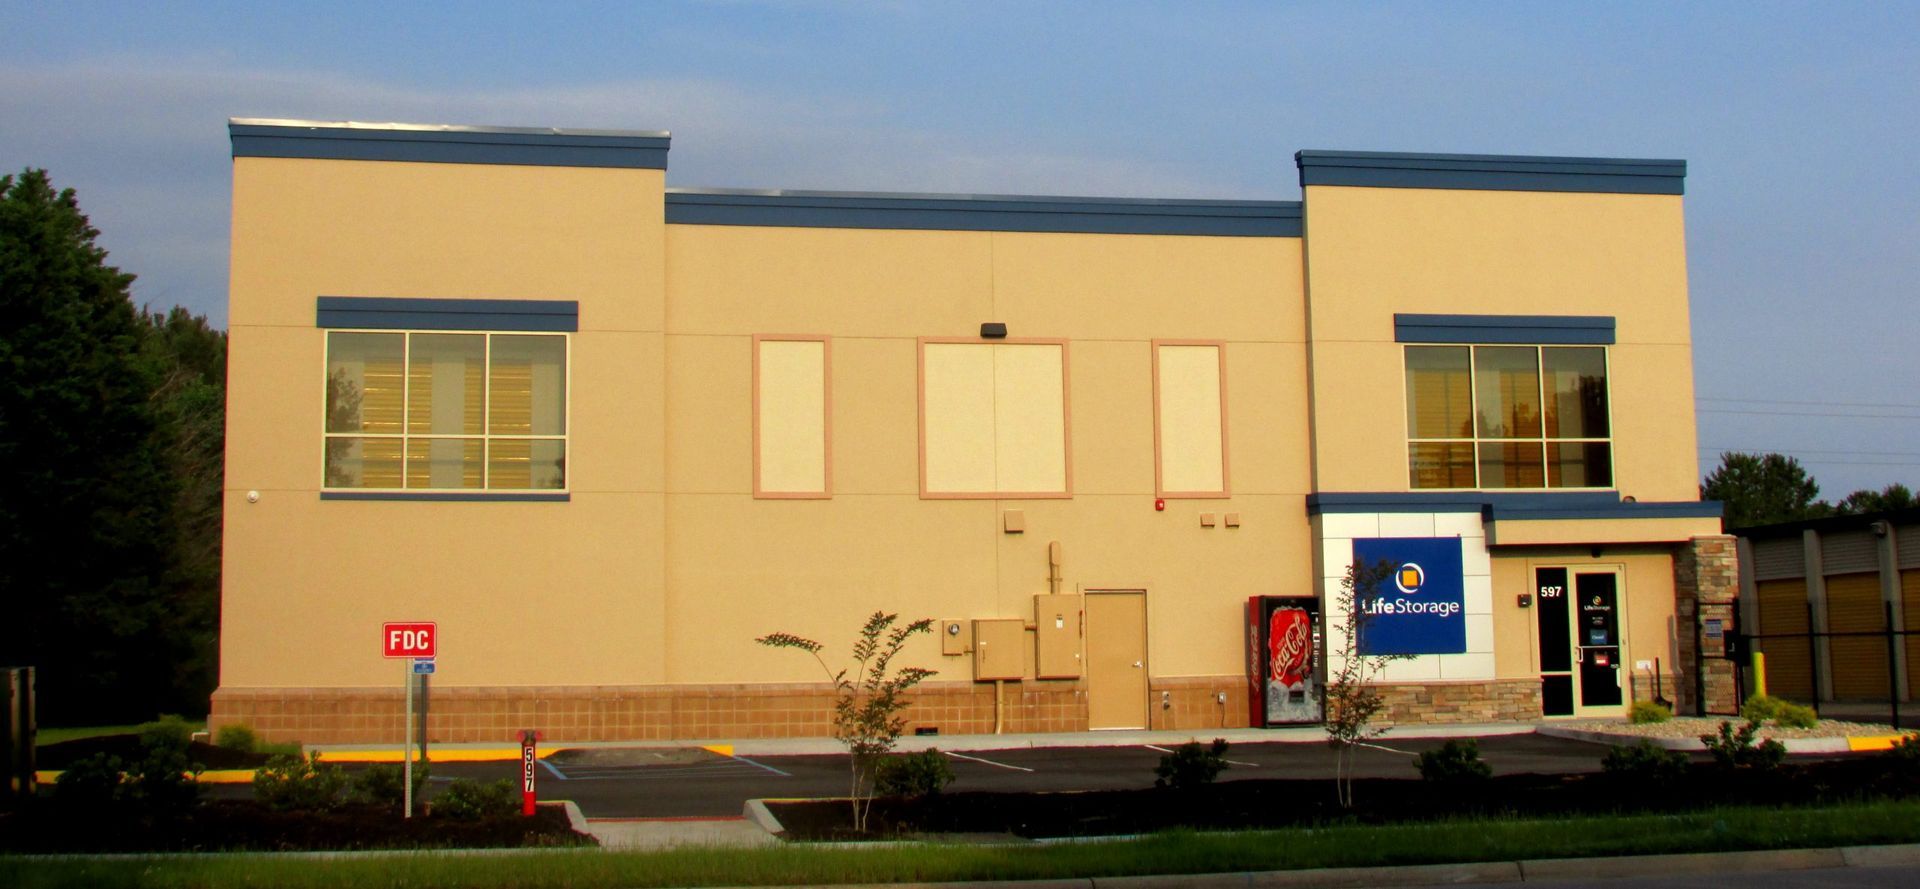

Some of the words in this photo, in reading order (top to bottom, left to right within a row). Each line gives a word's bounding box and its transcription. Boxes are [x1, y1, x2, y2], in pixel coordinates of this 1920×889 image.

[1540, 586, 1562, 597] 597
[390, 630, 429, 650] FDC
[1272, 614, 1307, 680] Coca-Cola
